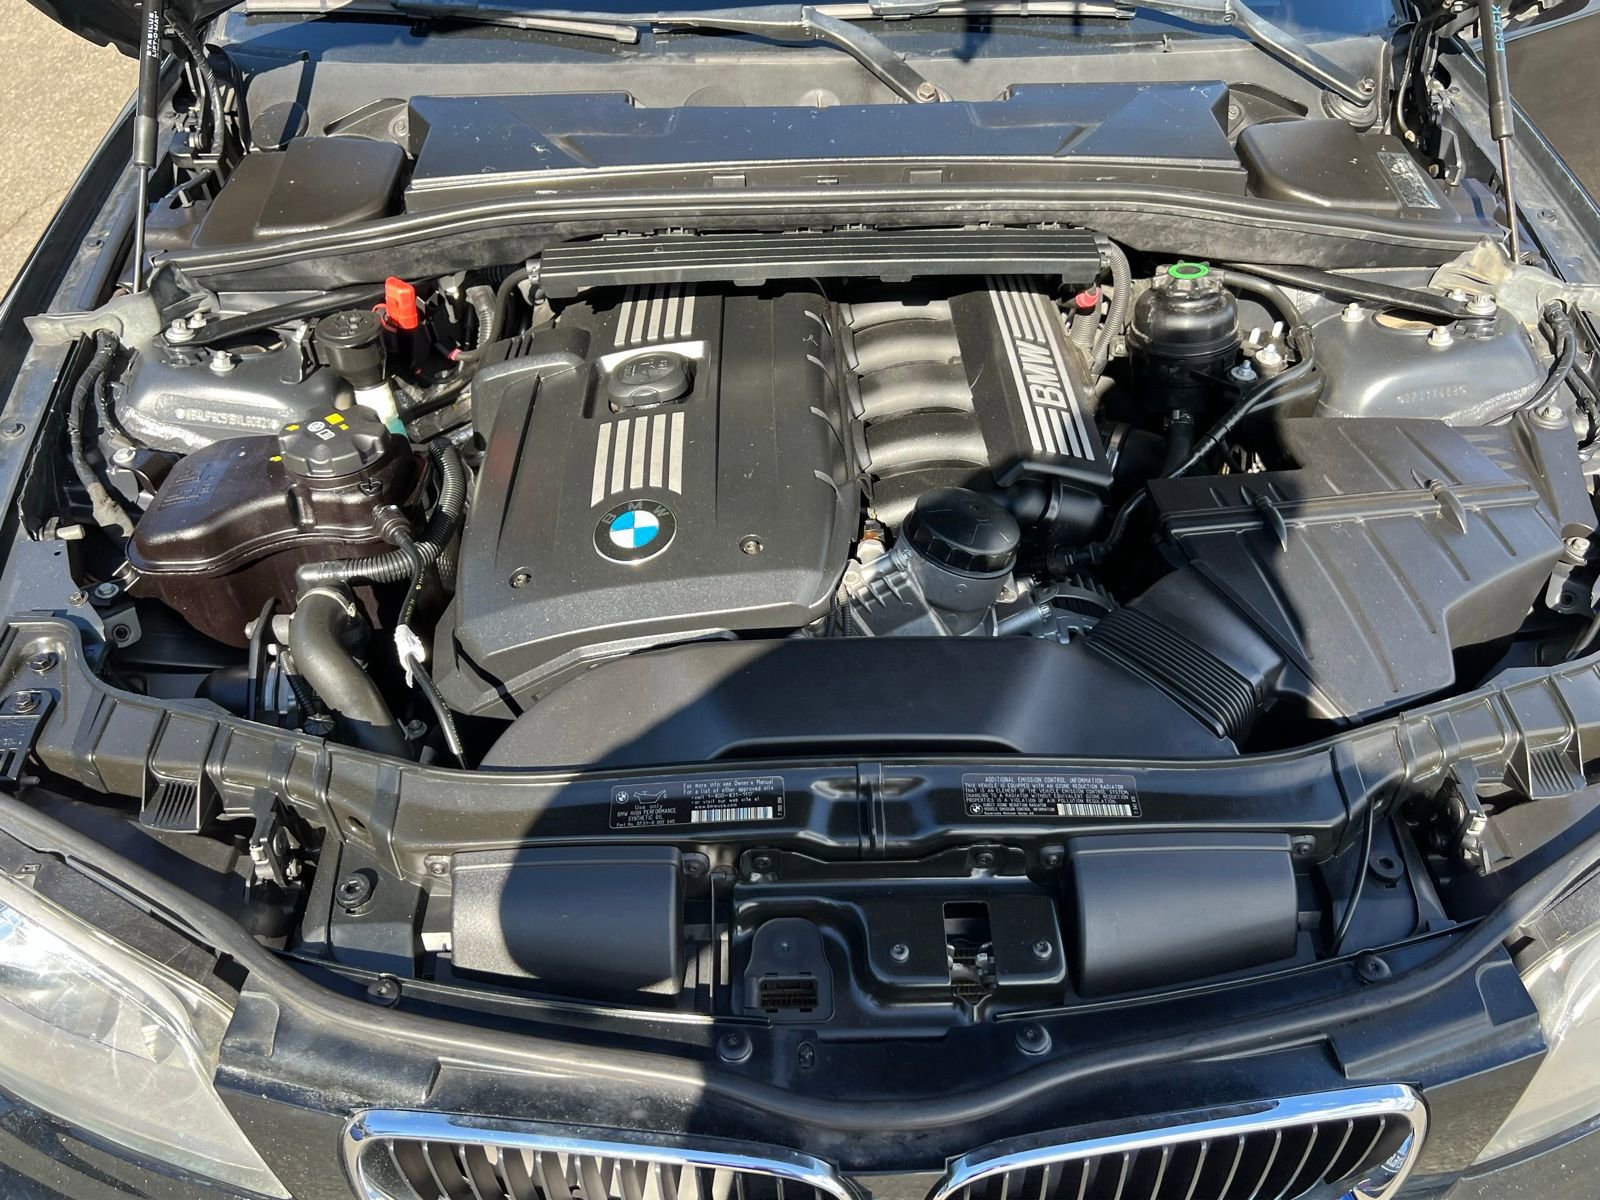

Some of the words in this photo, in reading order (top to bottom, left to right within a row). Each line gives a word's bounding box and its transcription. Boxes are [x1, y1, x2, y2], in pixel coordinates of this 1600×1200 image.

[146, 12, 154, 56] STABILUS
[1016, 340, 1068, 409] BMW
[600, 502, 670, 525] BMW
